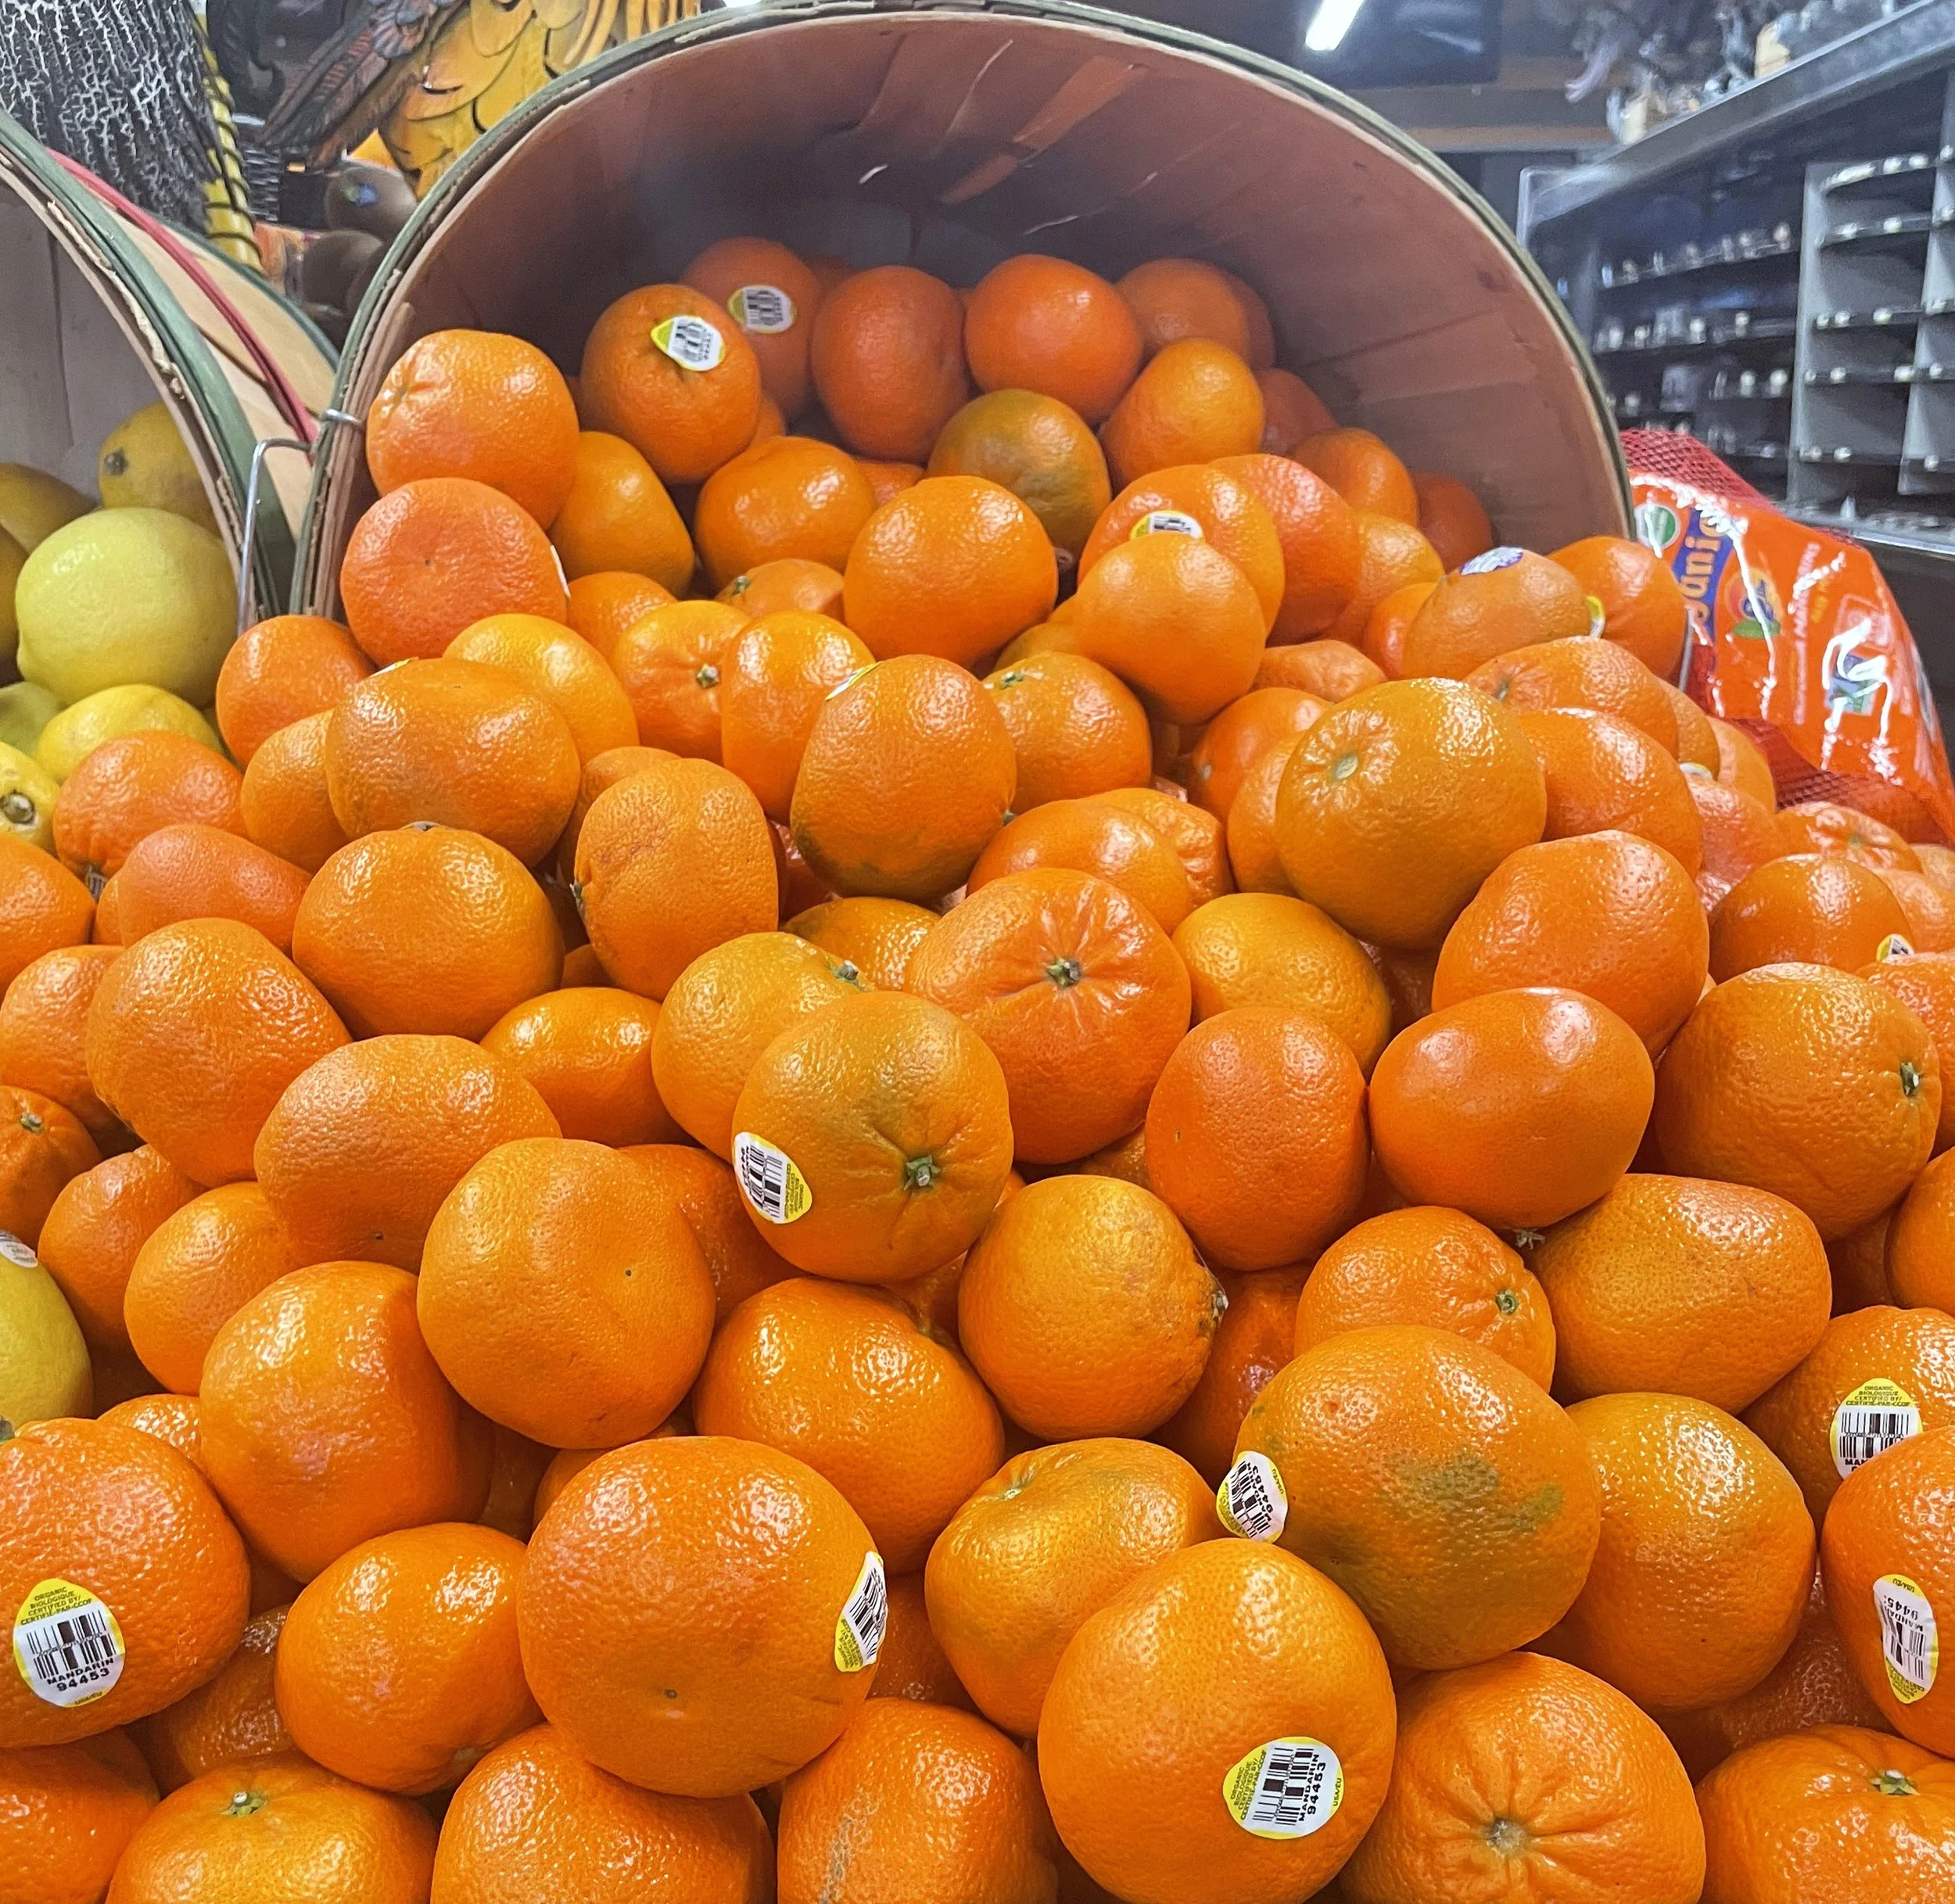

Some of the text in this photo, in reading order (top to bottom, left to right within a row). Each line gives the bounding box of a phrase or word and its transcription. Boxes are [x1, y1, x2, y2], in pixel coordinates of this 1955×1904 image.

[34, 1587, 68, 1601] ORGANIC
[46, 1658, 114, 1685] MANDARIN
[56, 1667, 110, 1691] 94453
[1230, 1766, 1245, 1800] ORGANIC
[1233, 1761, 1252, 1806] BIOLOGIQUE
[1238, 1775, 1253, 1810] CERTIFIED
[1298, 1754, 1320, 1822] MANDARIN
[1307, 1762, 1326, 1815] 94453
